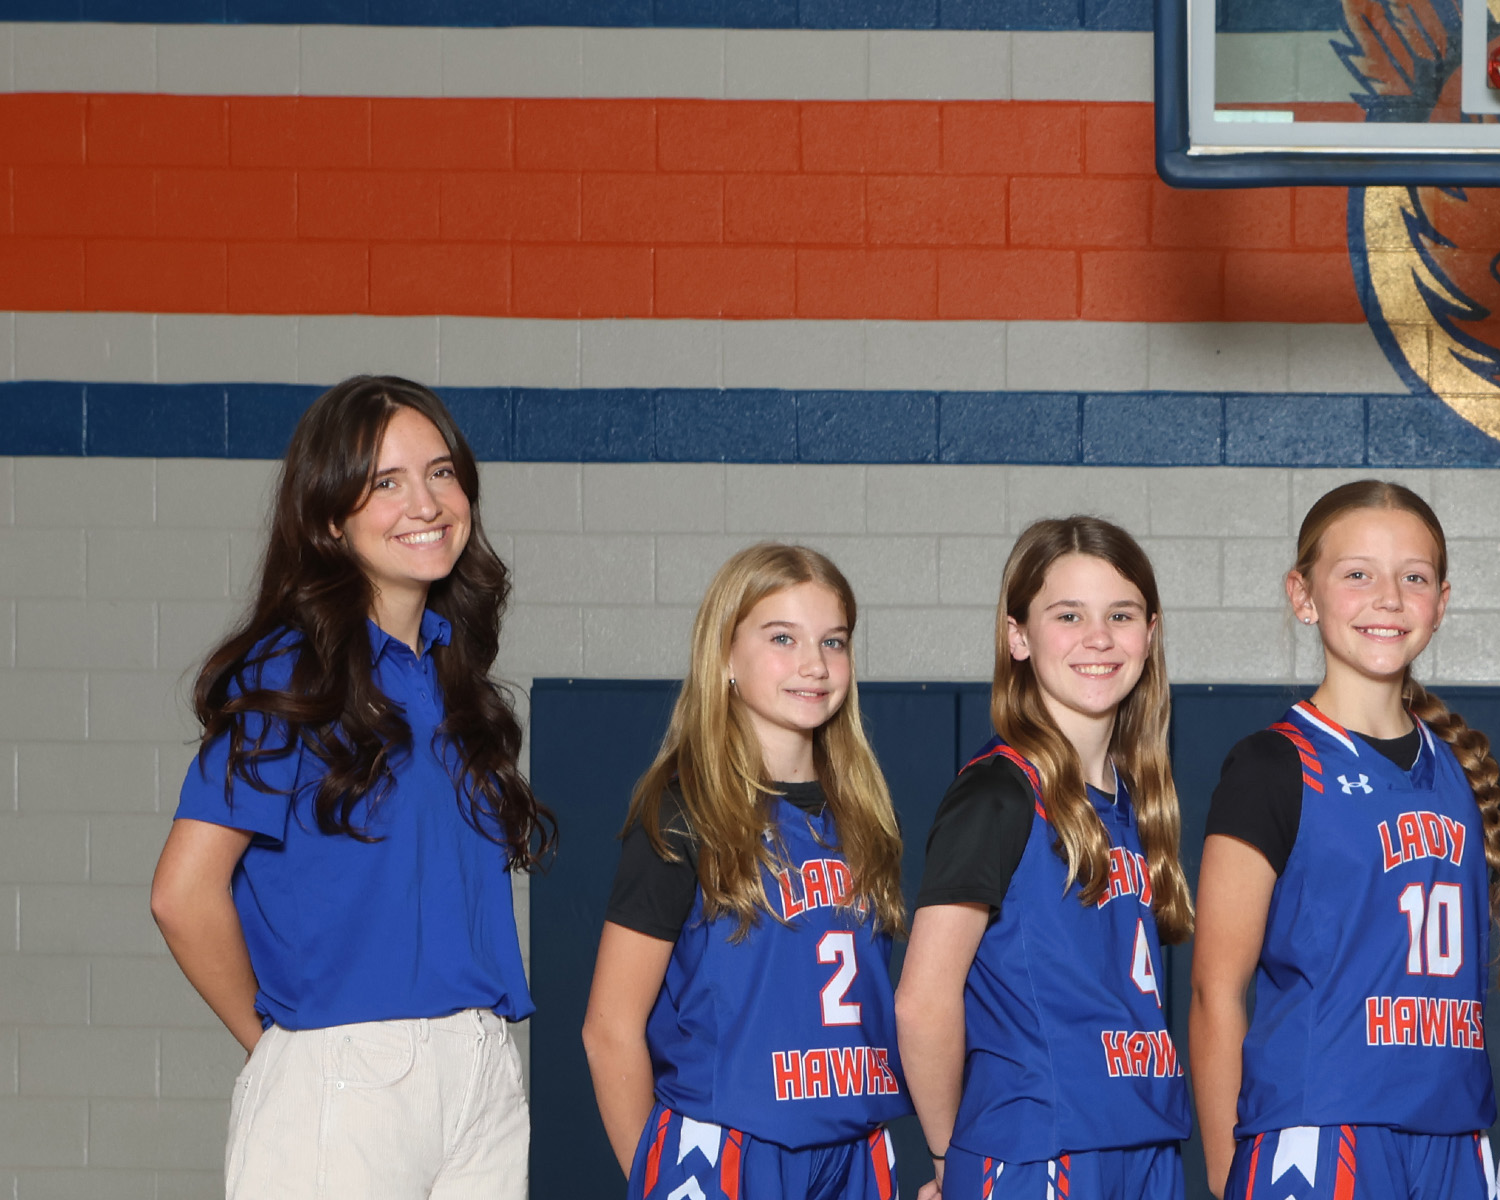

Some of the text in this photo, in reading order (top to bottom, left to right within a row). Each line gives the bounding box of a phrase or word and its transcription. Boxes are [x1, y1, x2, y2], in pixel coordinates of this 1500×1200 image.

[1377, 811, 1467, 873] LADY
[779, 859, 867, 921] LAD
[1398, 882, 1464, 978] 10
[816, 930, 862, 1026] 2
[1129, 918, 1162, 1009] 4
[1101, 1030, 1185, 1078] HAW
[1365, 996, 1485, 1050] HAWKS
